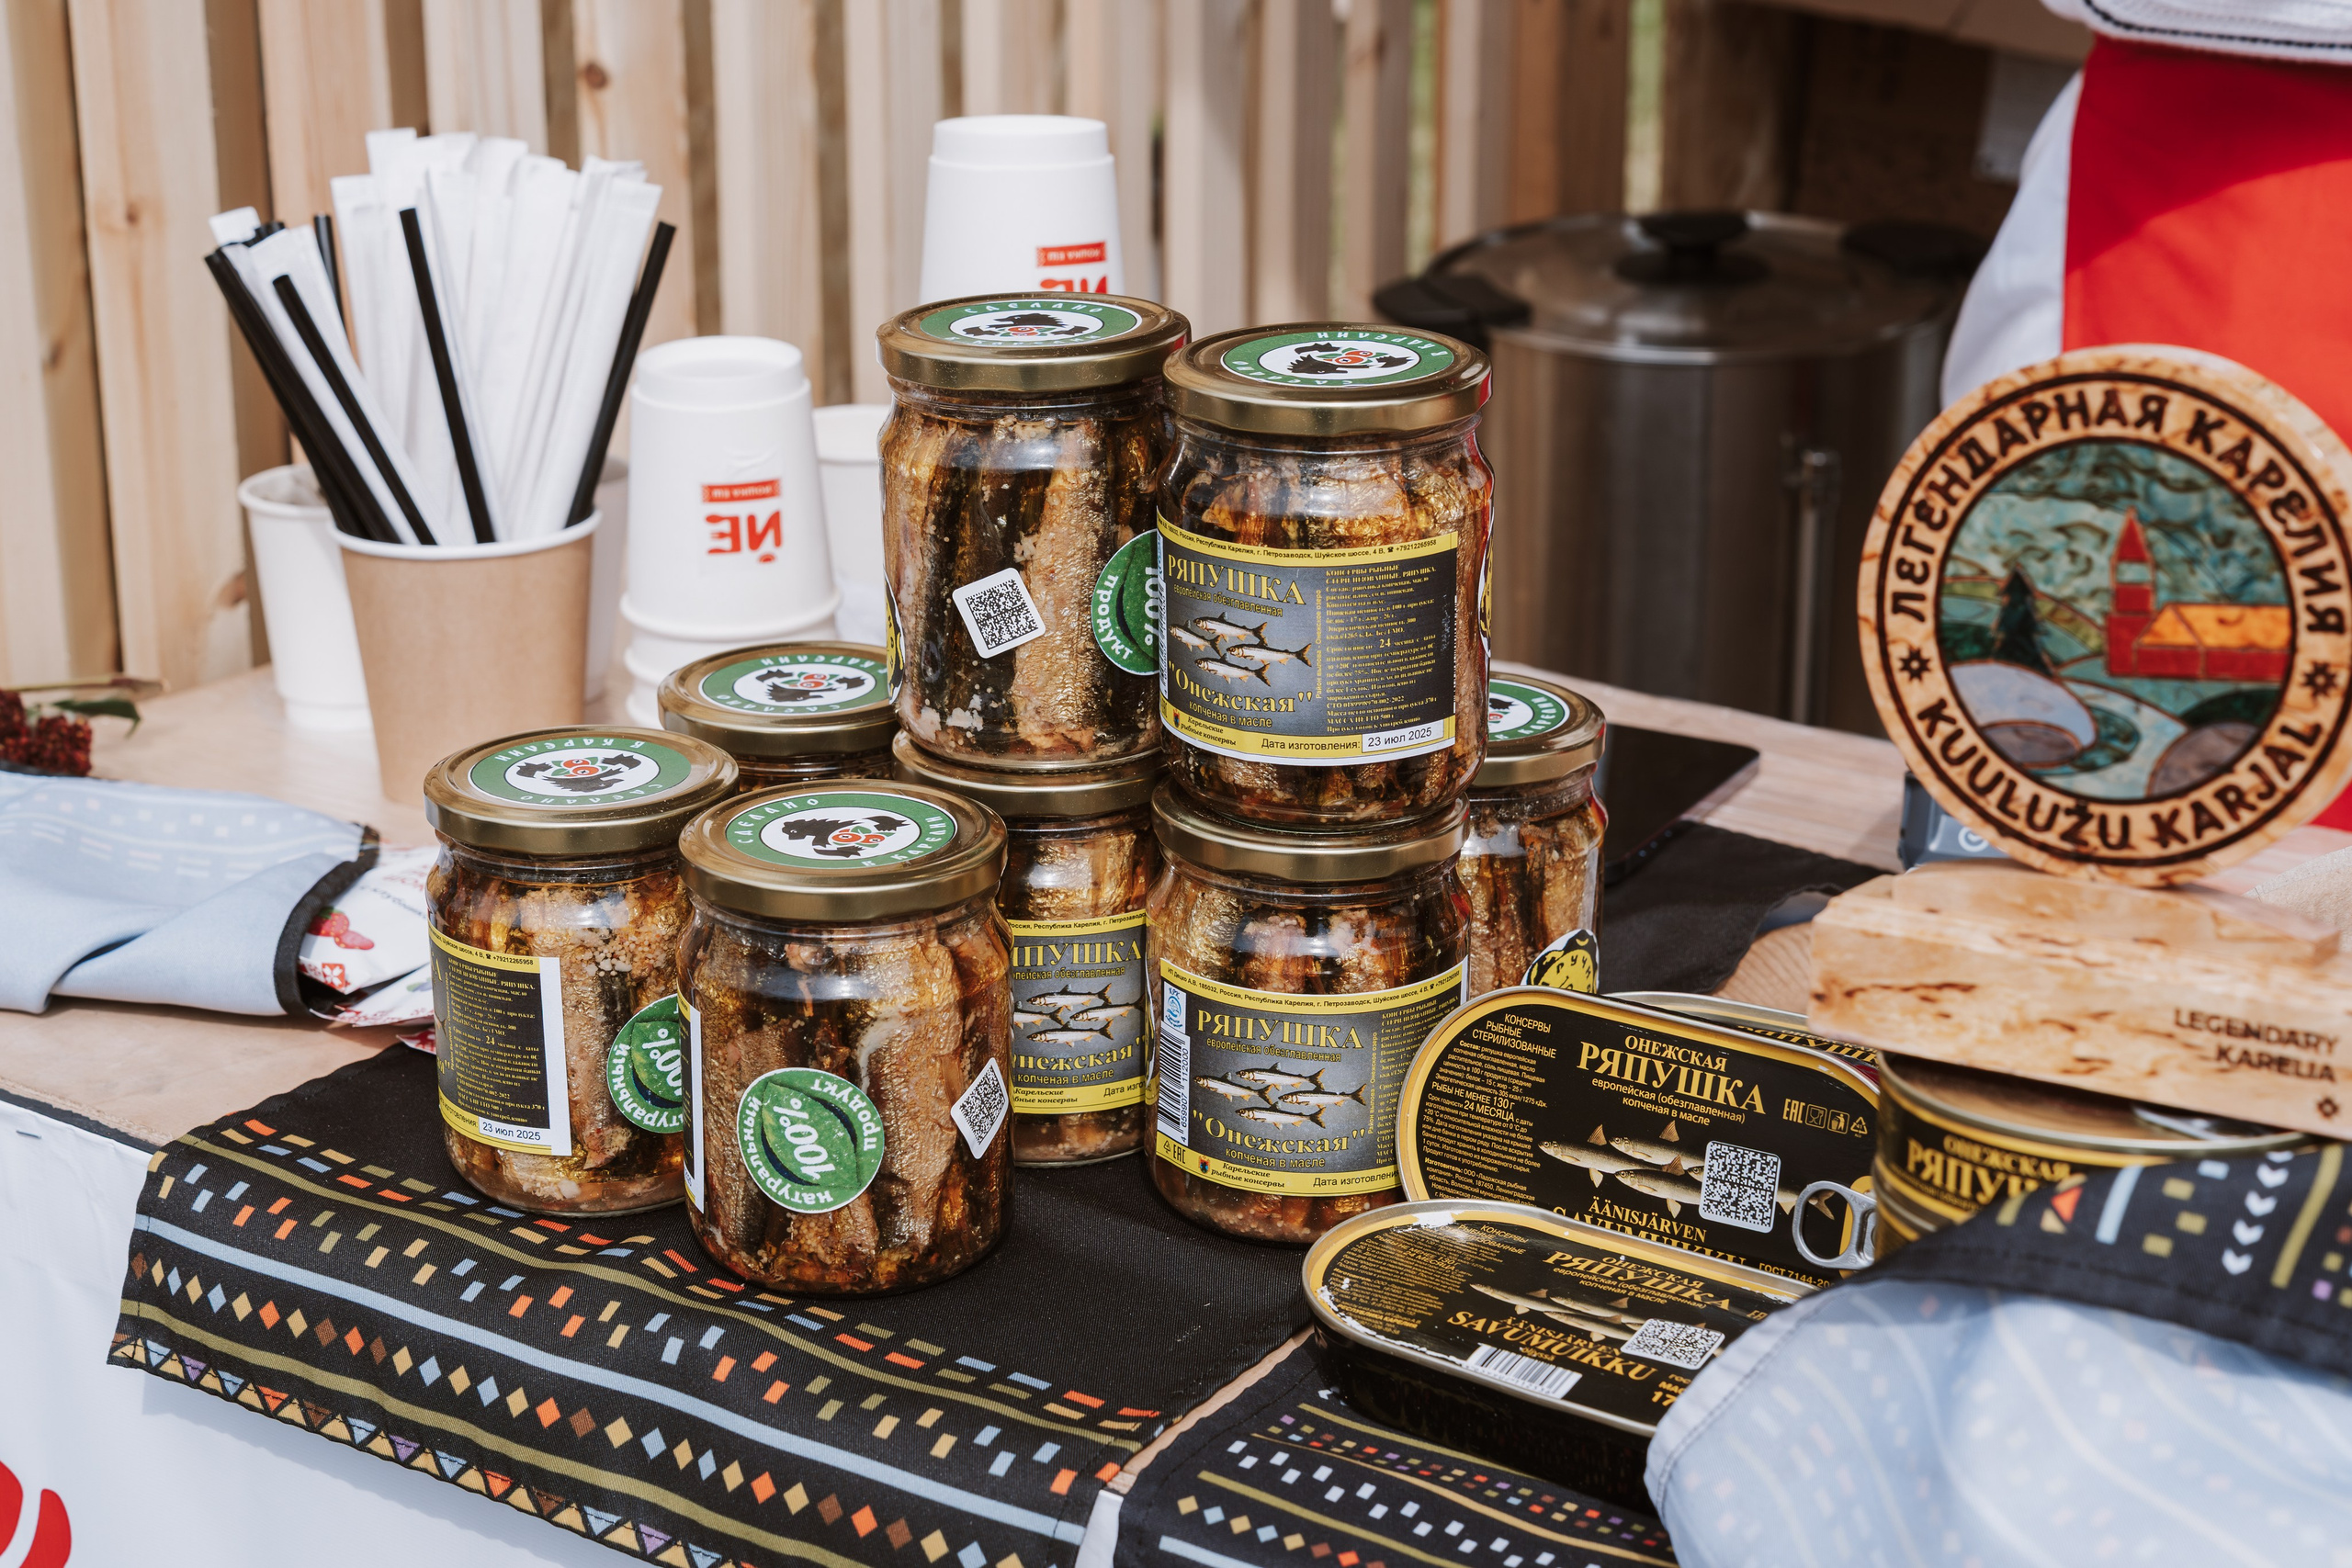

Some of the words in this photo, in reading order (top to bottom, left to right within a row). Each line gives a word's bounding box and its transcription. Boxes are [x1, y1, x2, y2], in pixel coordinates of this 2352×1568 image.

[1891, 389, 2170, 623] ЛЕГЕНДАРНАЯ
[2187, 410, 2346, 636] КАРЕЛИЯ
[1168, 554, 1306, 605] РЯПУШКА
[1095, 574, 1134, 660] продукт
[1213, 592, 1283, 617] обезглавленная
[1379, 638, 1391, 649] 24
[1168, 660, 1313, 713] "Онежская"
[1189, 701, 1228, 723] копченая
[1230, 716, 1237, 725] в
[1238, 717, 1273, 728] масле
[494, 737, 615, 761] КАРЕЛИИ
[1261, 738, 1286, 750] Дата
[1288, 741, 1361, 750] изготовления:
[1367, 737, 1382, 748] 23
[1384, 735, 1406, 746] июл
[1408, 727, 1432, 741] 2025
[1917, 699, 2132, 851] KUULUŽU
[2151, 720, 2323, 849] KARJAL
[519, 782, 664, 805] СДЕЛАНО
[733, 797, 820, 845] СДЕЛАНО
[890, 815, 947, 863] КАРЕЛИИ
[1012, 940, 1142, 968] ПУШКА
[1054, 965, 1125, 979] обезглавленная
[1323, 998, 1373, 1008] Петрозаводск,
[1197, 1009, 1364, 1049] РЯПУШКА
[1486, 1020, 1522, 1038] РЫБНЫЕ
[1504, 1013, 1552, 1033] КОНСЕРВЫ
[2173, 1007, 2340, 1055] LEGENDARY
[485, 1035, 495, 1045] 24
[1205, 1037, 1261, 1055] европейская
[1263, 1045, 1342, 1063] обезглавленная
[1472, 1028, 1557, 1059] СТЕРИЛИЗОВАННЫЕ
[1624, 1034, 1727, 1072] ОНЕЖСКАЯ
[1017, 1073, 1069, 1085] копченая
[1071, 1074, 1080, 1083] в
[1081, 1068, 1114, 1083] масле
[1471, 1066, 1481, 1076] 100
[1576, 1041, 1767, 1115] РЯПУШКА
[2214, 1043, 2338, 1084] KARELIA
[1103, 1086, 1125, 1098] Дата
[1431, 1081, 1453, 1094] РЫБЫ
[1454, 1087, 1465, 1097] НЕ
[1464, 1090, 1491, 1105] МЕНЕЕ
[1492, 1095, 1510, 1110] 130
[1591, 1076, 1656, 1101] европейская
[1657, 1091, 1746, 1124] (обезглавленная)
[810, 1078, 882, 1152] продукт
[1464, 1100, 1475, 1111] 24
[1476, 1103, 1515, 1122] МЕСЯЦА
[1622, 1095, 1670, 1116] копченая
[1671, 1107, 1679, 1117] в
[1679, 1109, 1711, 1126] масле
[482, 1122, 493, 1133] 23
[495, 1127, 514, 1138] июл
[516, 1129, 541, 1141] 2025
[772, 1097, 836, 1181] 100%
[1193, 1109, 1365, 1154] "Онежская"
[741, 1095, 833, 1205] натуральный
[1226, 1148, 1276, 1168] копченая
[1278, 1158, 1286, 1168] в
[1289, 1158, 1325, 1168] масле
[1211, 1168, 1242, 1183] рыбные
[1243, 1177, 1285, 1188] консервы
[1222, 1162, 1271, 1179] Карельские
[1313, 1177, 1338, 1188] Дата
[1589, 1196, 1707, 1243] ÄÄNISJÄRVEN
[1542, 1250, 1731, 1312] РЯПУШКА
[1601, 1256, 1705, 1290] ОНЕЖСКАЯ
[1553, 1267, 1618, 1287] европейская
[1617, 1281, 1707, 1310] (обезглавленная)
[1578, 1279, 1629, 1296] копченая
[1636, 1291, 1668, 1305] масле
[1447, 1311, 1658, 1381] SAVUMUIKKU
[1499, 1315, 1623, 1358] ÄÄNISJÄRVEN
